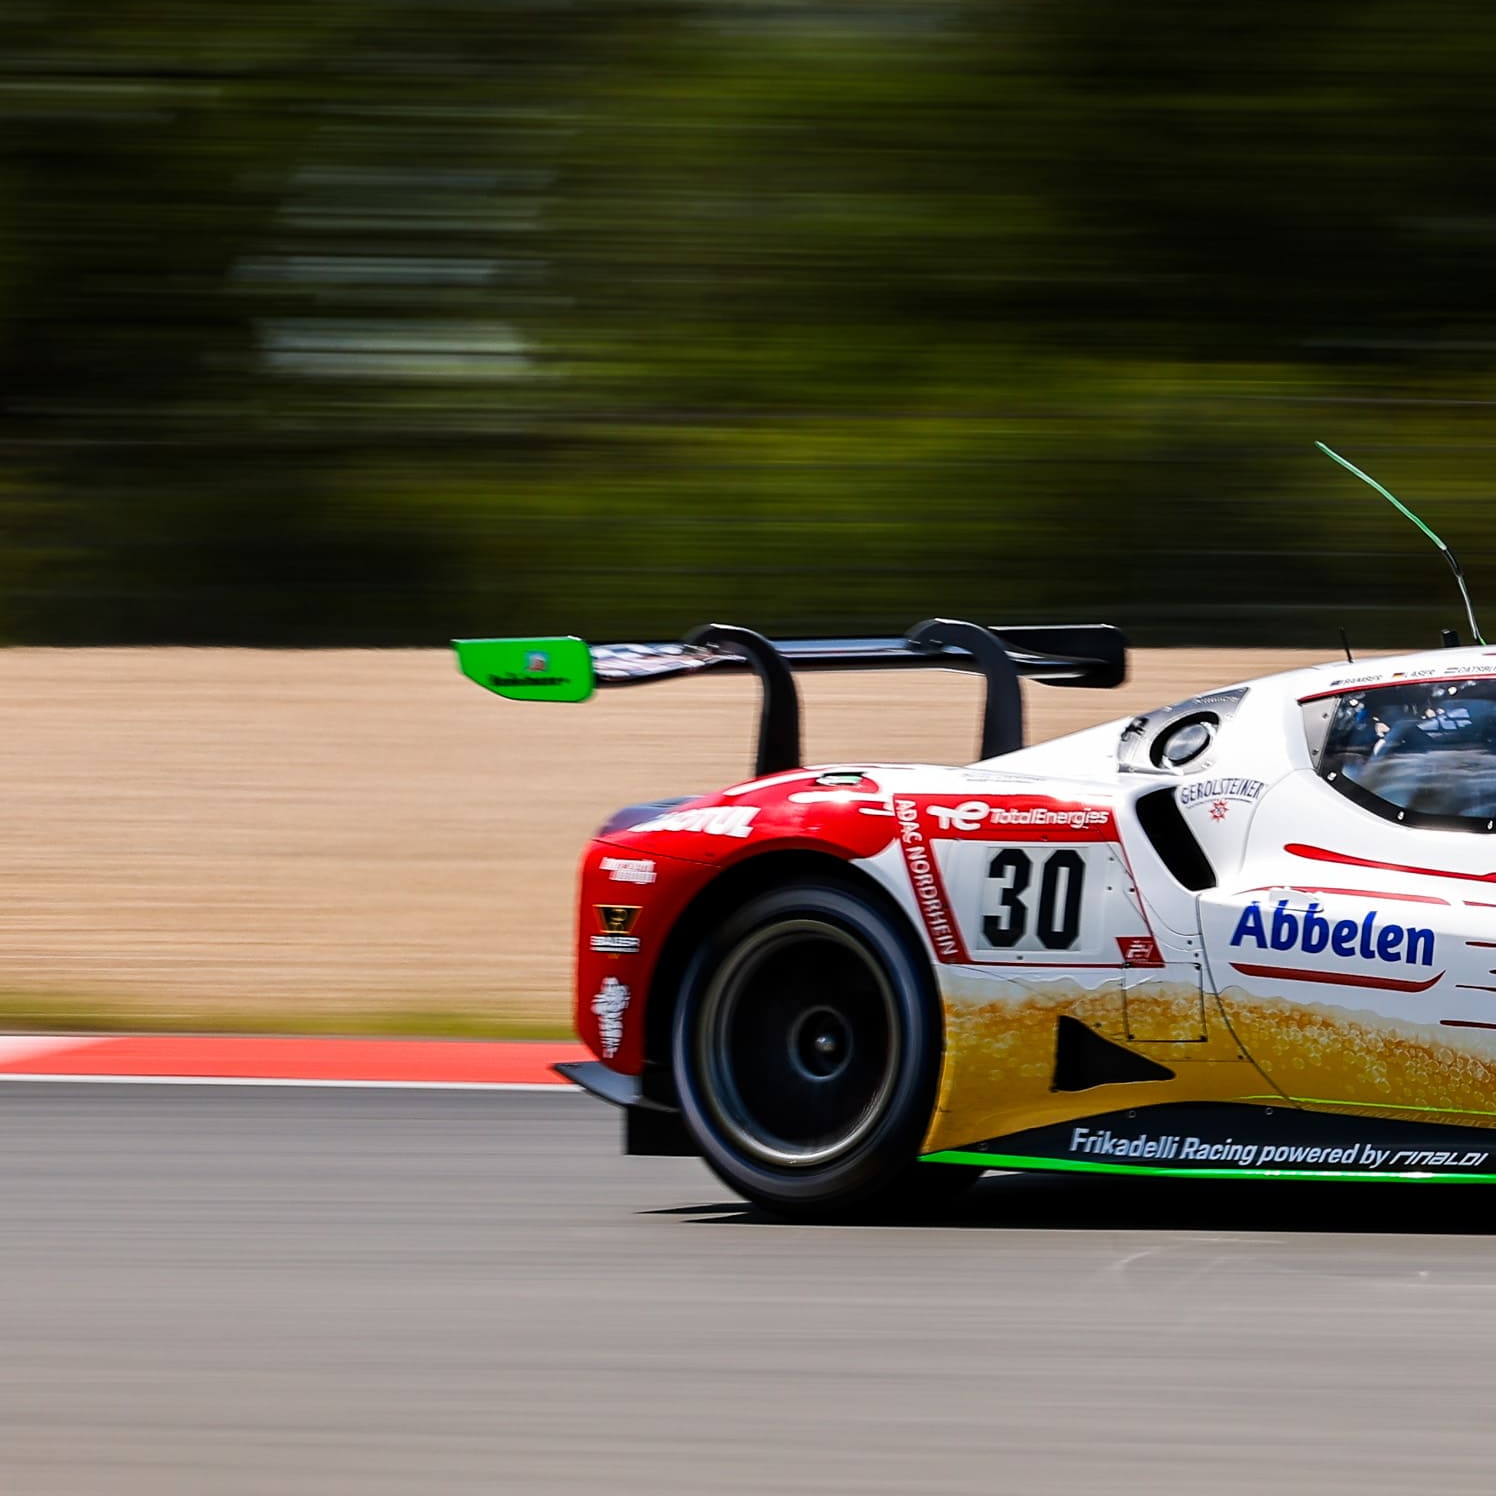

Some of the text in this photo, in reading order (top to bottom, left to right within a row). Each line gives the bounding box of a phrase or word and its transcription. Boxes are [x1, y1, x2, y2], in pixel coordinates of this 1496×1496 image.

[1181, 778, 1265, 804] GEROLSTEINER
[628, 805, 761, 838] TUL
[989, 807, 1109, 829] TotalEnergies
[895, 799, 959, 956] ADAC NORDRHEIN
[982, 848, 1086, 950] 30
[1230, 899, 1436, 967] Abbelen
[1069, 1127, 1180, 1159] Frikadelli
[1179, 1136, 1257, 1166] Racing
[1256, 1143, 1360, 1166] powered
[1359, 1144, 1391, 1168] by
